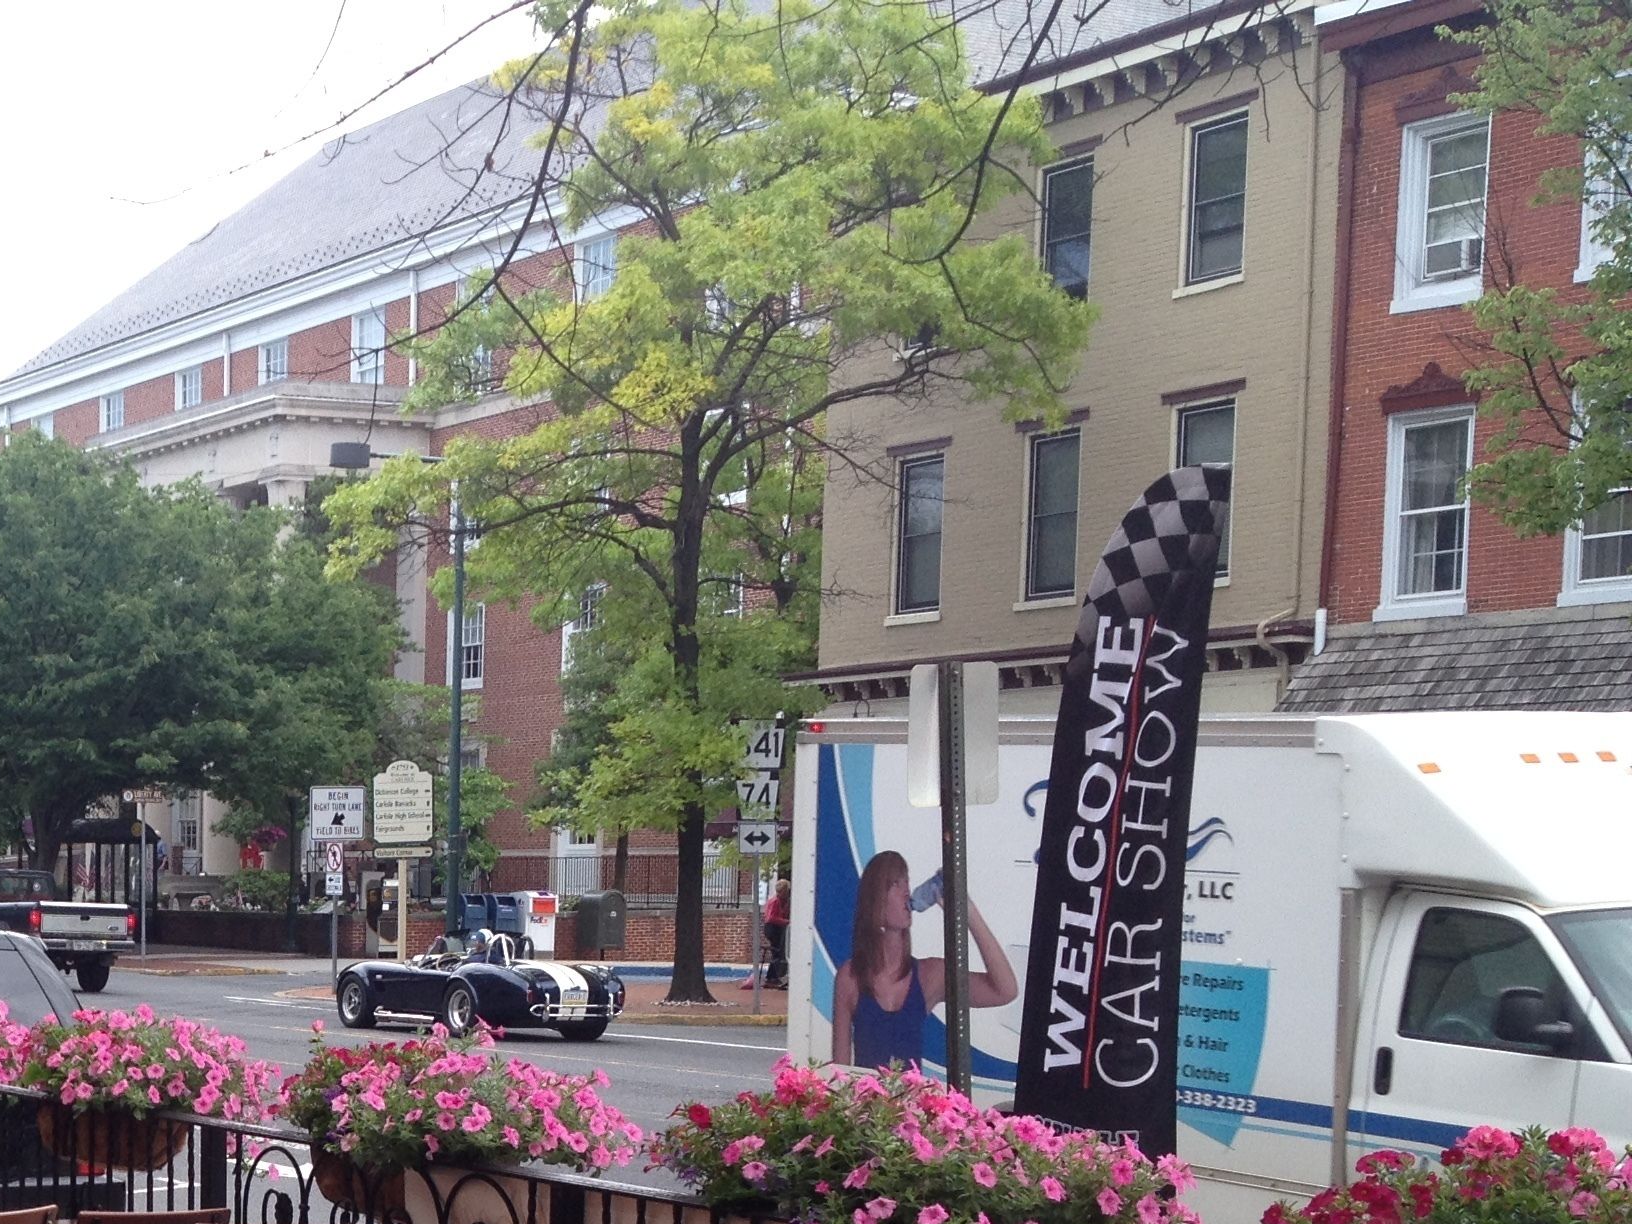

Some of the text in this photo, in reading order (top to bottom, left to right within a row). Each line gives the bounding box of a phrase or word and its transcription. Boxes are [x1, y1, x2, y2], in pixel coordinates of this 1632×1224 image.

[328, 791, 348, 800] BEGIN
[742, 783, 771, 809] 74
[313, 803, 362, 811] RIGHT TURN LANE
[316, 826, 333, 835] YIELD
[335, 826, 342, 835] TO
[1044, 615, 1144, 1072] WELCOME
[1094, 620, 1190, 1088] CAR SHOW
[1198, 880, 1234, 900] LLC
[1182, 929, 1232, 945] stems"
[1193, 973, 1244, 992] Repairs
[1178, 1004, 1240, 1022] etergents
[1183, 1034, 1195, 1048] &
[1198, 1035, 1229, 1052] Hair
[1182, 1064, 1230, 1083] Clothes
[1176, 1089, 1257, 1113] -338-2323
